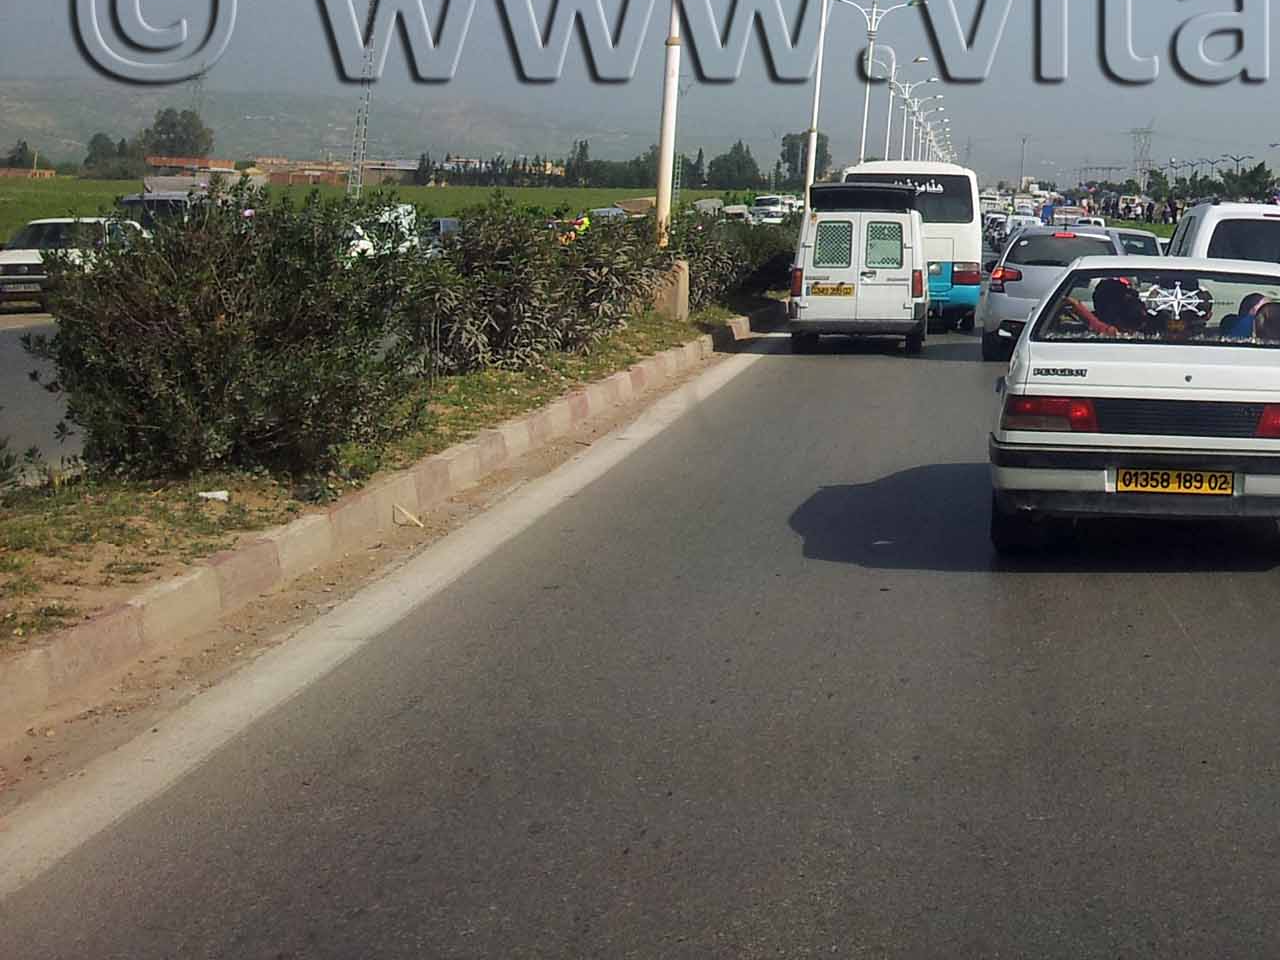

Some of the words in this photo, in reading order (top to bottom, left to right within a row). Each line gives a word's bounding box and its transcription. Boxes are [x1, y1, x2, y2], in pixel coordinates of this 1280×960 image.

[1122, 471, 1171, 489] 01358
[1176, 472, 1204, 490] 189
[1208, 474, 1228, 490] 02
